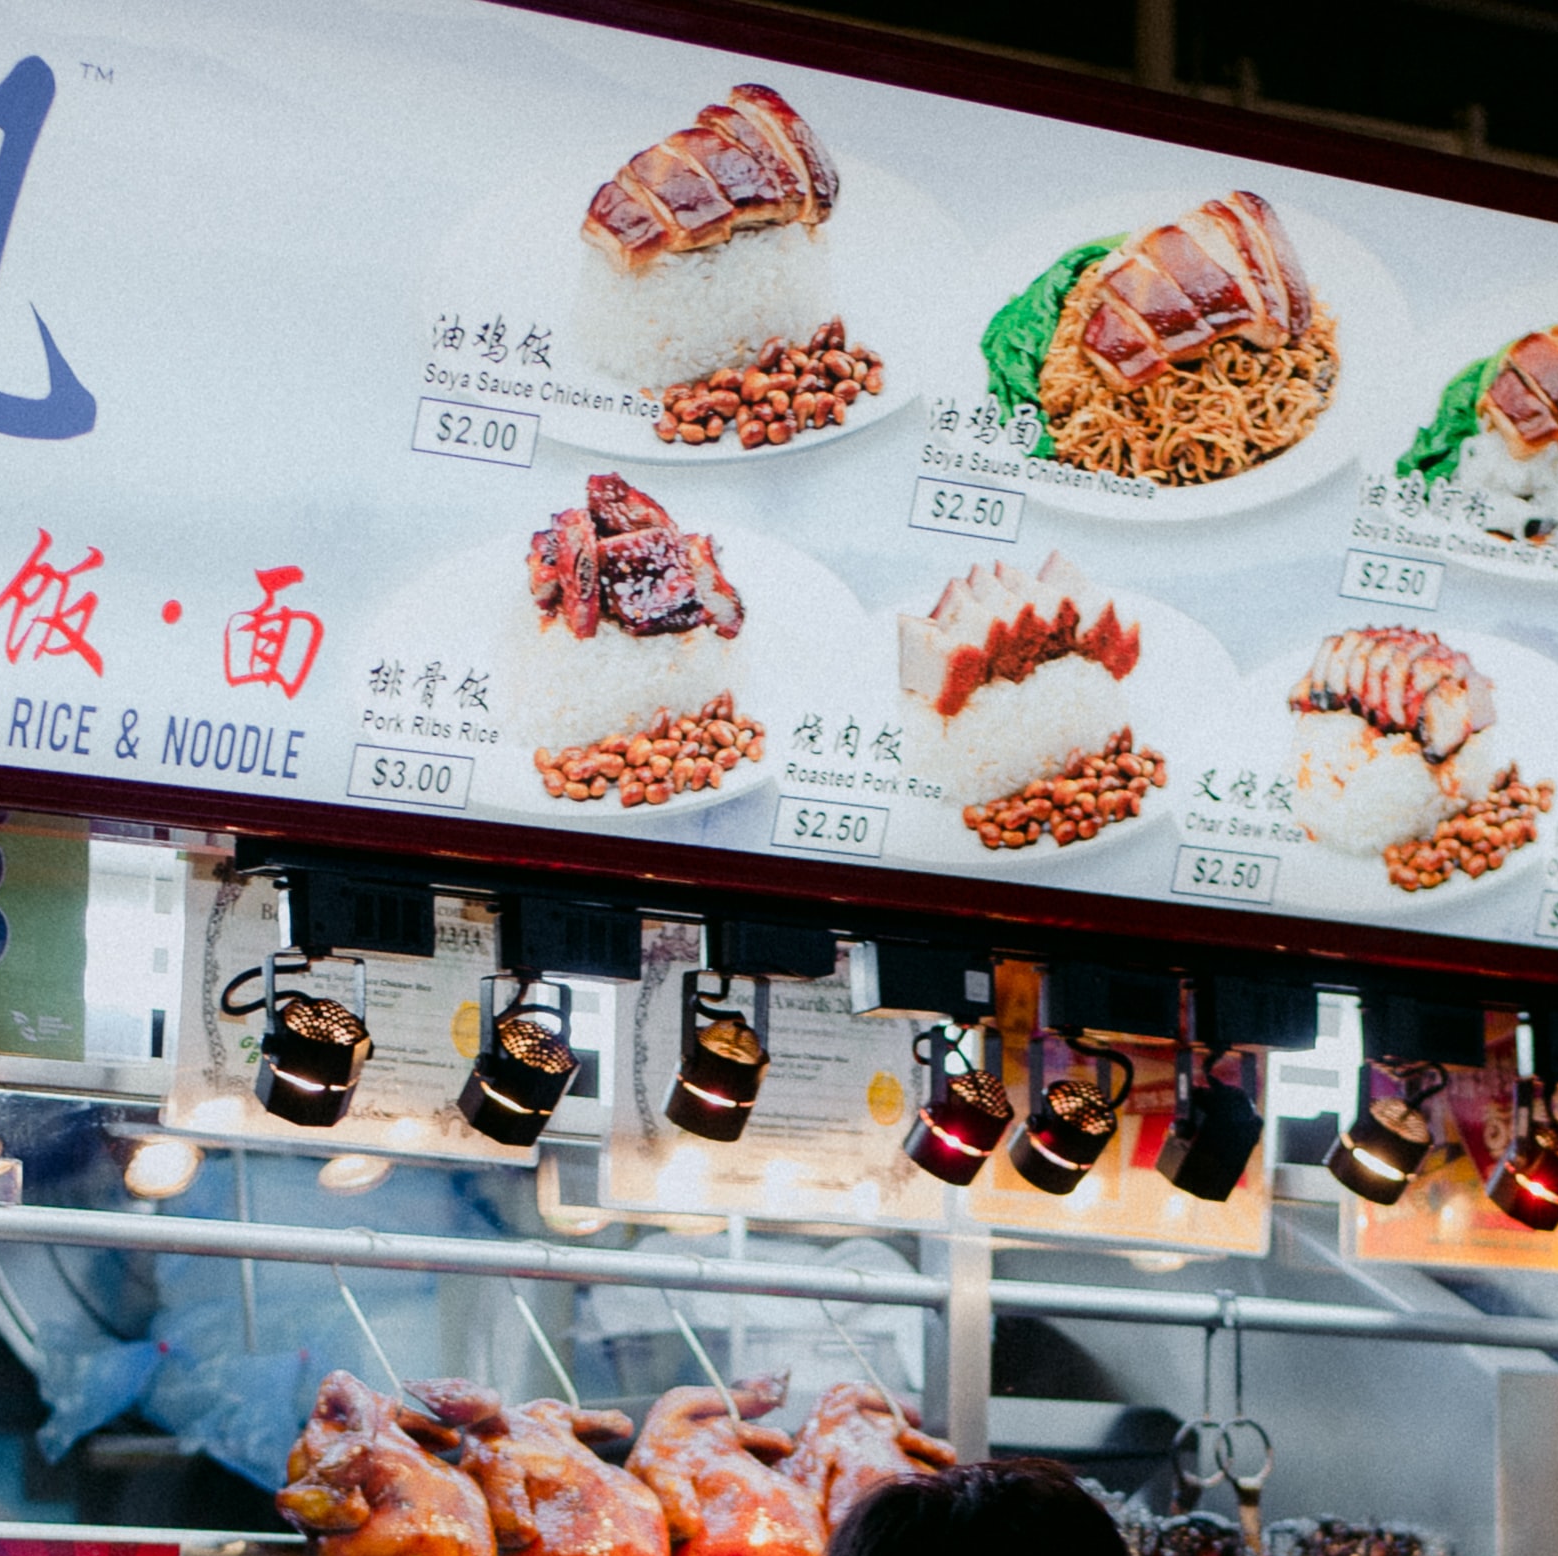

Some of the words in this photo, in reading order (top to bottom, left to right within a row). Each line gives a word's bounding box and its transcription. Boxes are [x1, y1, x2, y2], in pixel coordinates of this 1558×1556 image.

[432, 313, 554, 370] 油鸡饭
[424, 362, 470, 391] Soya
[476, 371, 534, 398] Sauce
[541, 381, 614, 411] Chicken
[620, 394, 662, 418] Rice
[436, 410, 518, 452] $2.00
[921, 444, 963, 472] Soya
[969, 451, 1021, 477] Sauce
[1026, 459, 1093, 490] Chicken
[1097, 469, 1157, 499] Noodle
[931, 490, 1005, 527] $2.50
[1359, 561, 1427, 596] $2.50
[8, 695, 97, 755] RICE
[114, 708, 141, 760] &
[161, 715, 306, 780] NOODLE
[362, 709, 404, 733] Pork
[411, 715, 452, 739] Ribs
[458, 721, 499, 744] Rice
[371, 757, 452, 794] $3.00
[784, 762, 856, 789] Roasted
[861, 771, 901, 794] Pork
[907, 777, 943, 799] Rice
[793, 808, 869, 844] $2.50
[1192, 856, 1262, 889] $2.50
